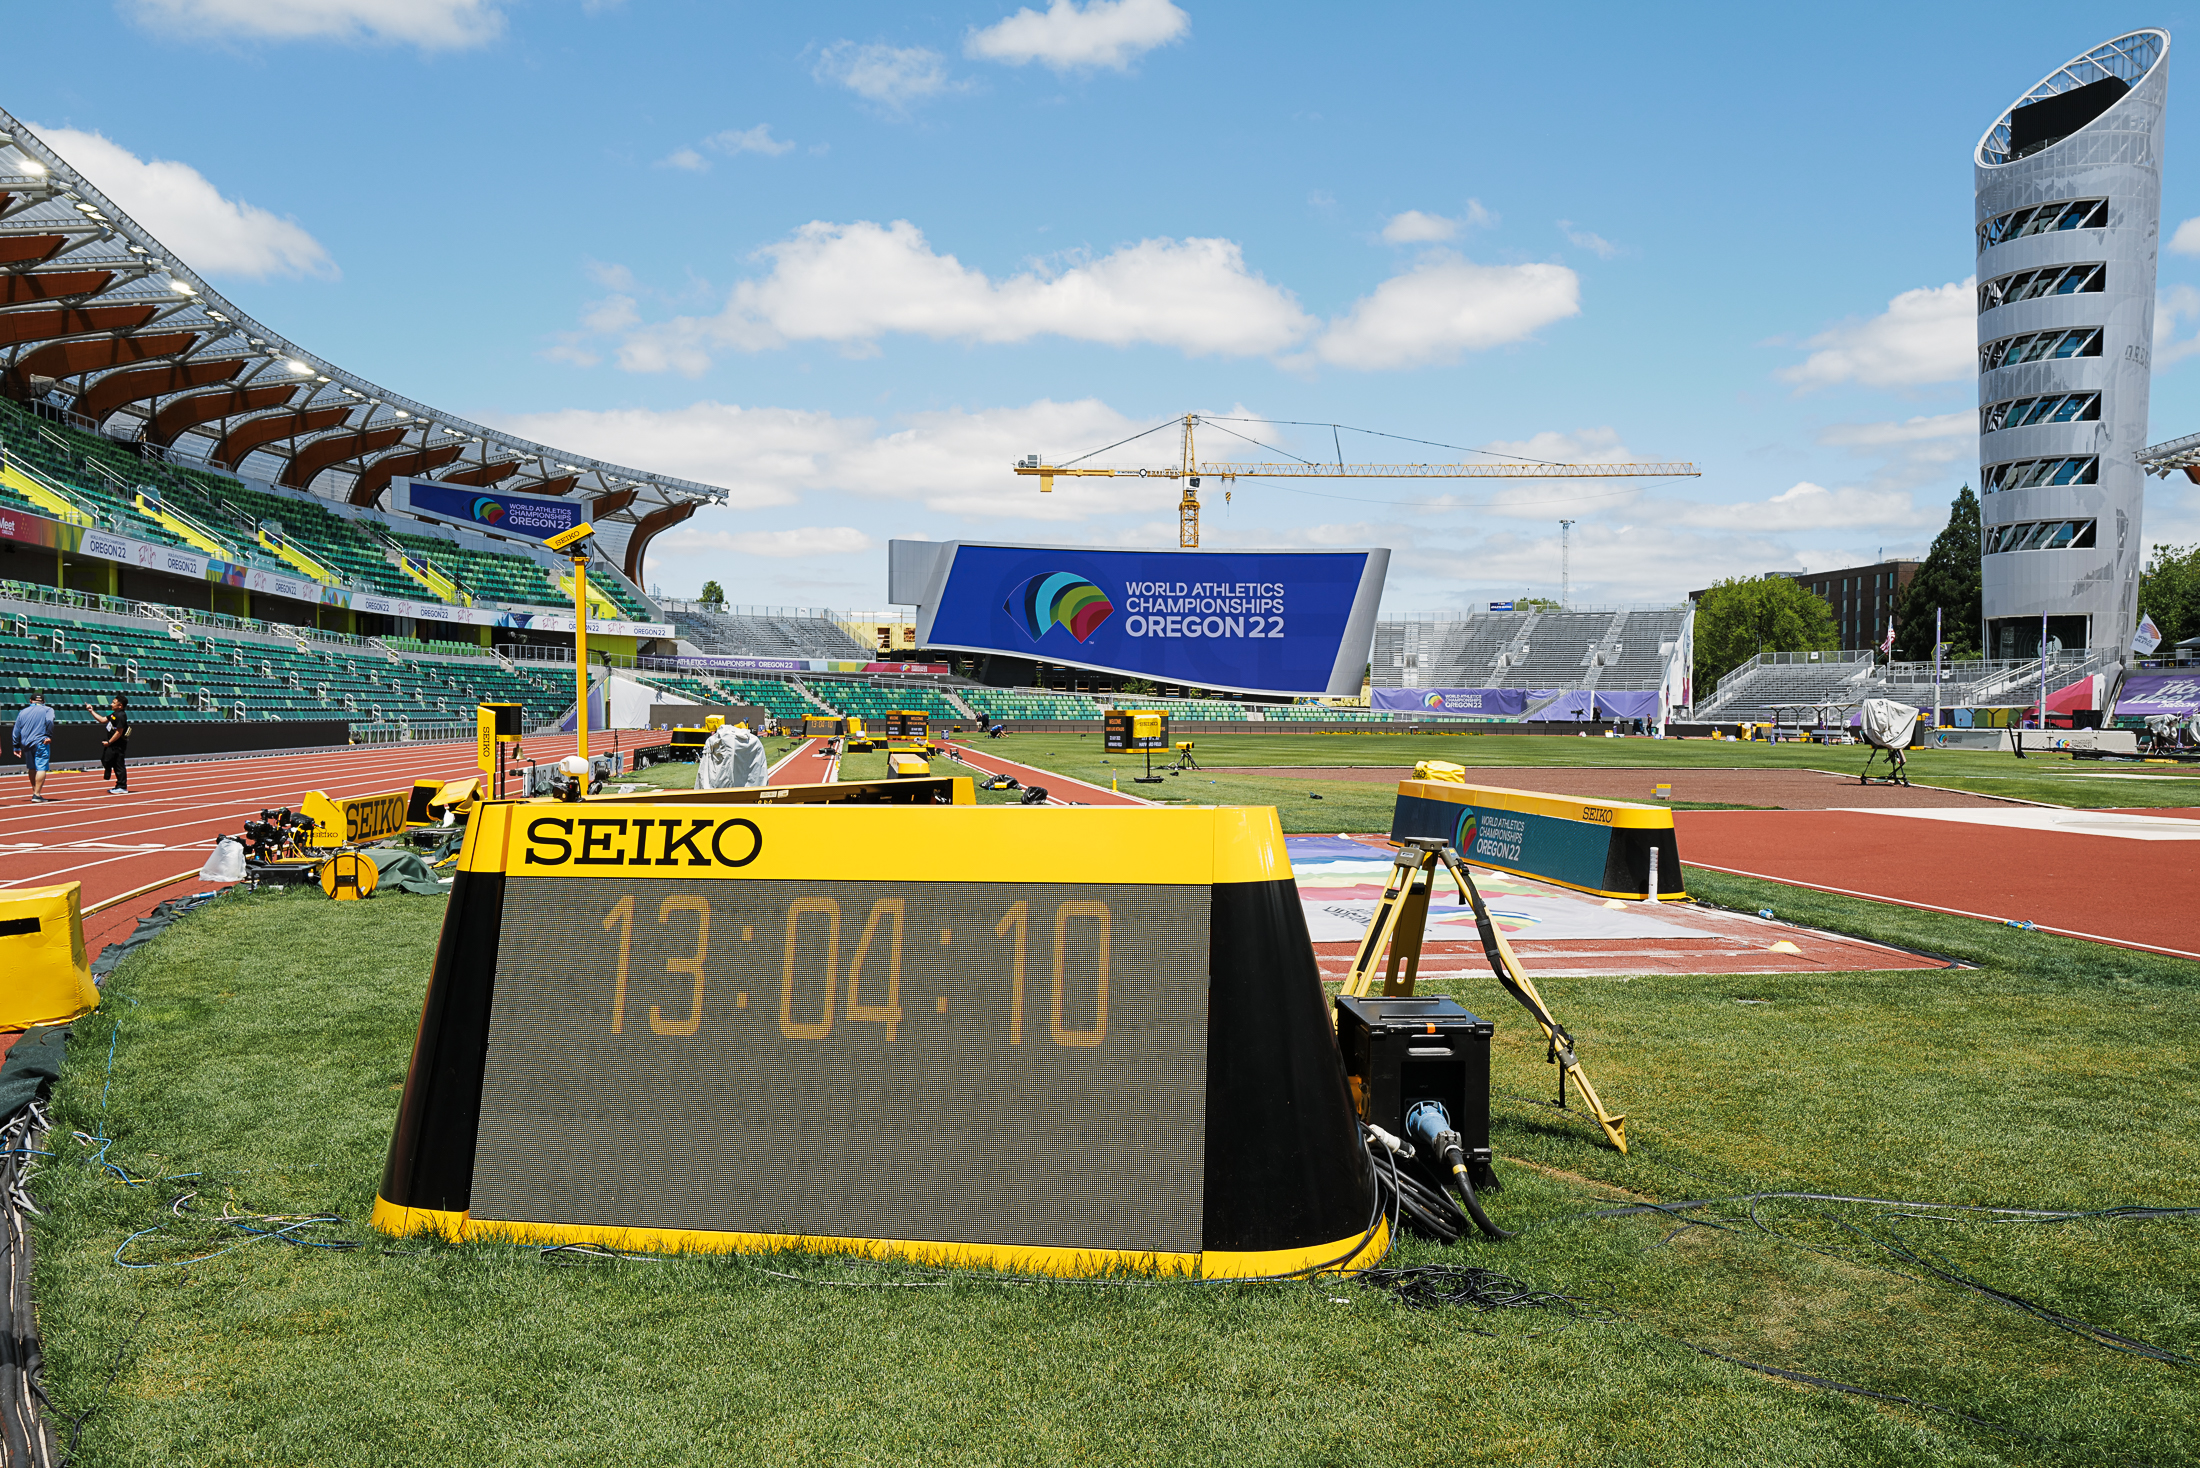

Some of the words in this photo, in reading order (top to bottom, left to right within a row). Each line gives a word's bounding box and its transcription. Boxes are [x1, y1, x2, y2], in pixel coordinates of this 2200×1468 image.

[509, 503, 535, 512] WORLD
[535, 506, 572, 515] ATHLETICS
[509, 509, 572, 521] CHAMPIONSHIPS
[554, 530, 580, 547] SEIKO
[1126, 581, 1188, 596] WORLD
[1191, 583, 1285, 597] ATHLETICS
[1126, 597, 1285, 614] CHAMPIONSHIPS
[709, 659, 756, 668] CHAMPIONSHIPS
[482, 726, 490, 758] SEIKO
[346, 796, 405, 842] SEIKO
[1481, 815, 1498, 827] WORLD
[1497, 819, 1525, 832] ATHLETICS
[1582, 806, 1614, 824] SEIKO
[525, 817, 763, 868] SEIKO
[1479, 826, 1523, 844] CHAMPIONSHIPS
